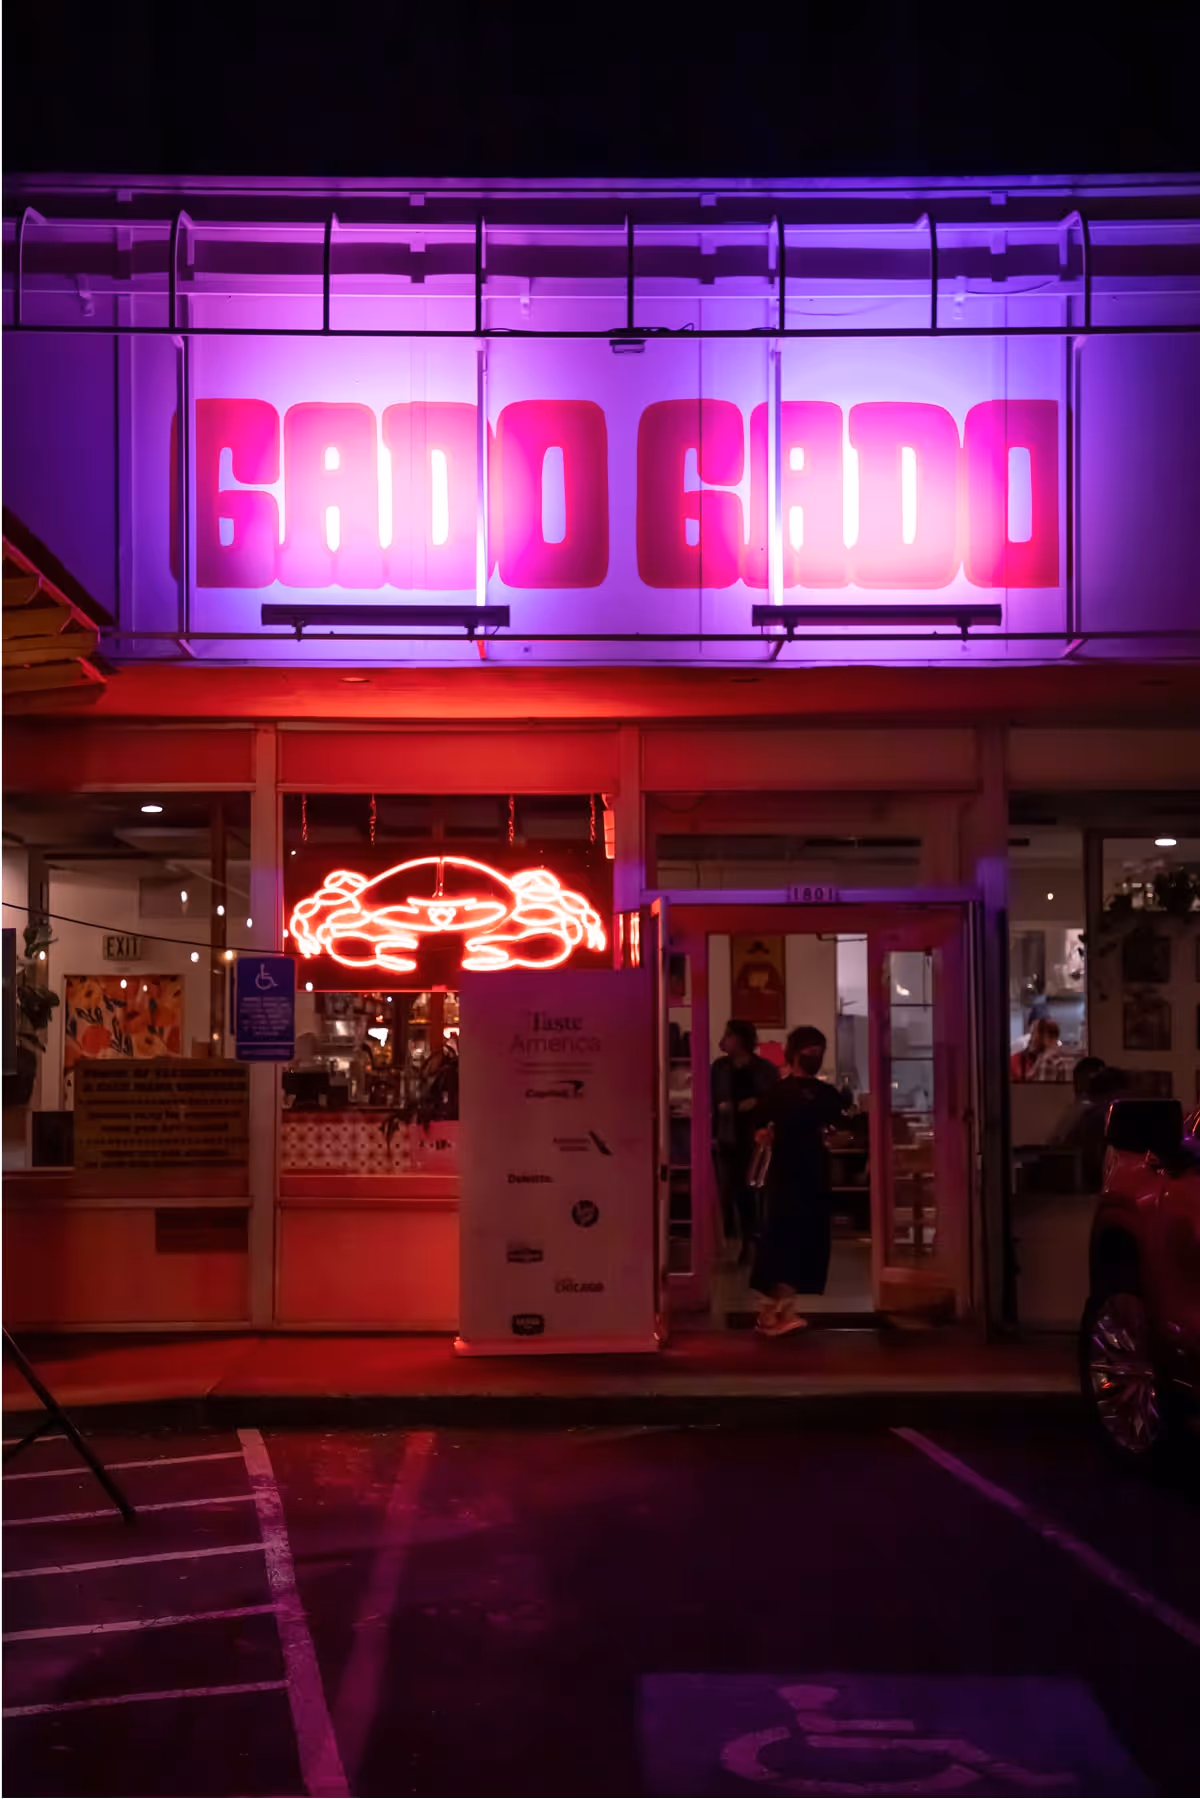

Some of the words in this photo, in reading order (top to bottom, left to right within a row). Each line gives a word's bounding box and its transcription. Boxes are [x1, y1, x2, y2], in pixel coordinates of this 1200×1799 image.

[169, 398, 609, 590] GADO
[636, 398, 1060, 590] GADO
[793, 887, 833, 902] 1801
[107, 936, 138, 957] EXIT
[528, 1010, 583, 1032] Taste
[510, 1033, 602, 1053] America
